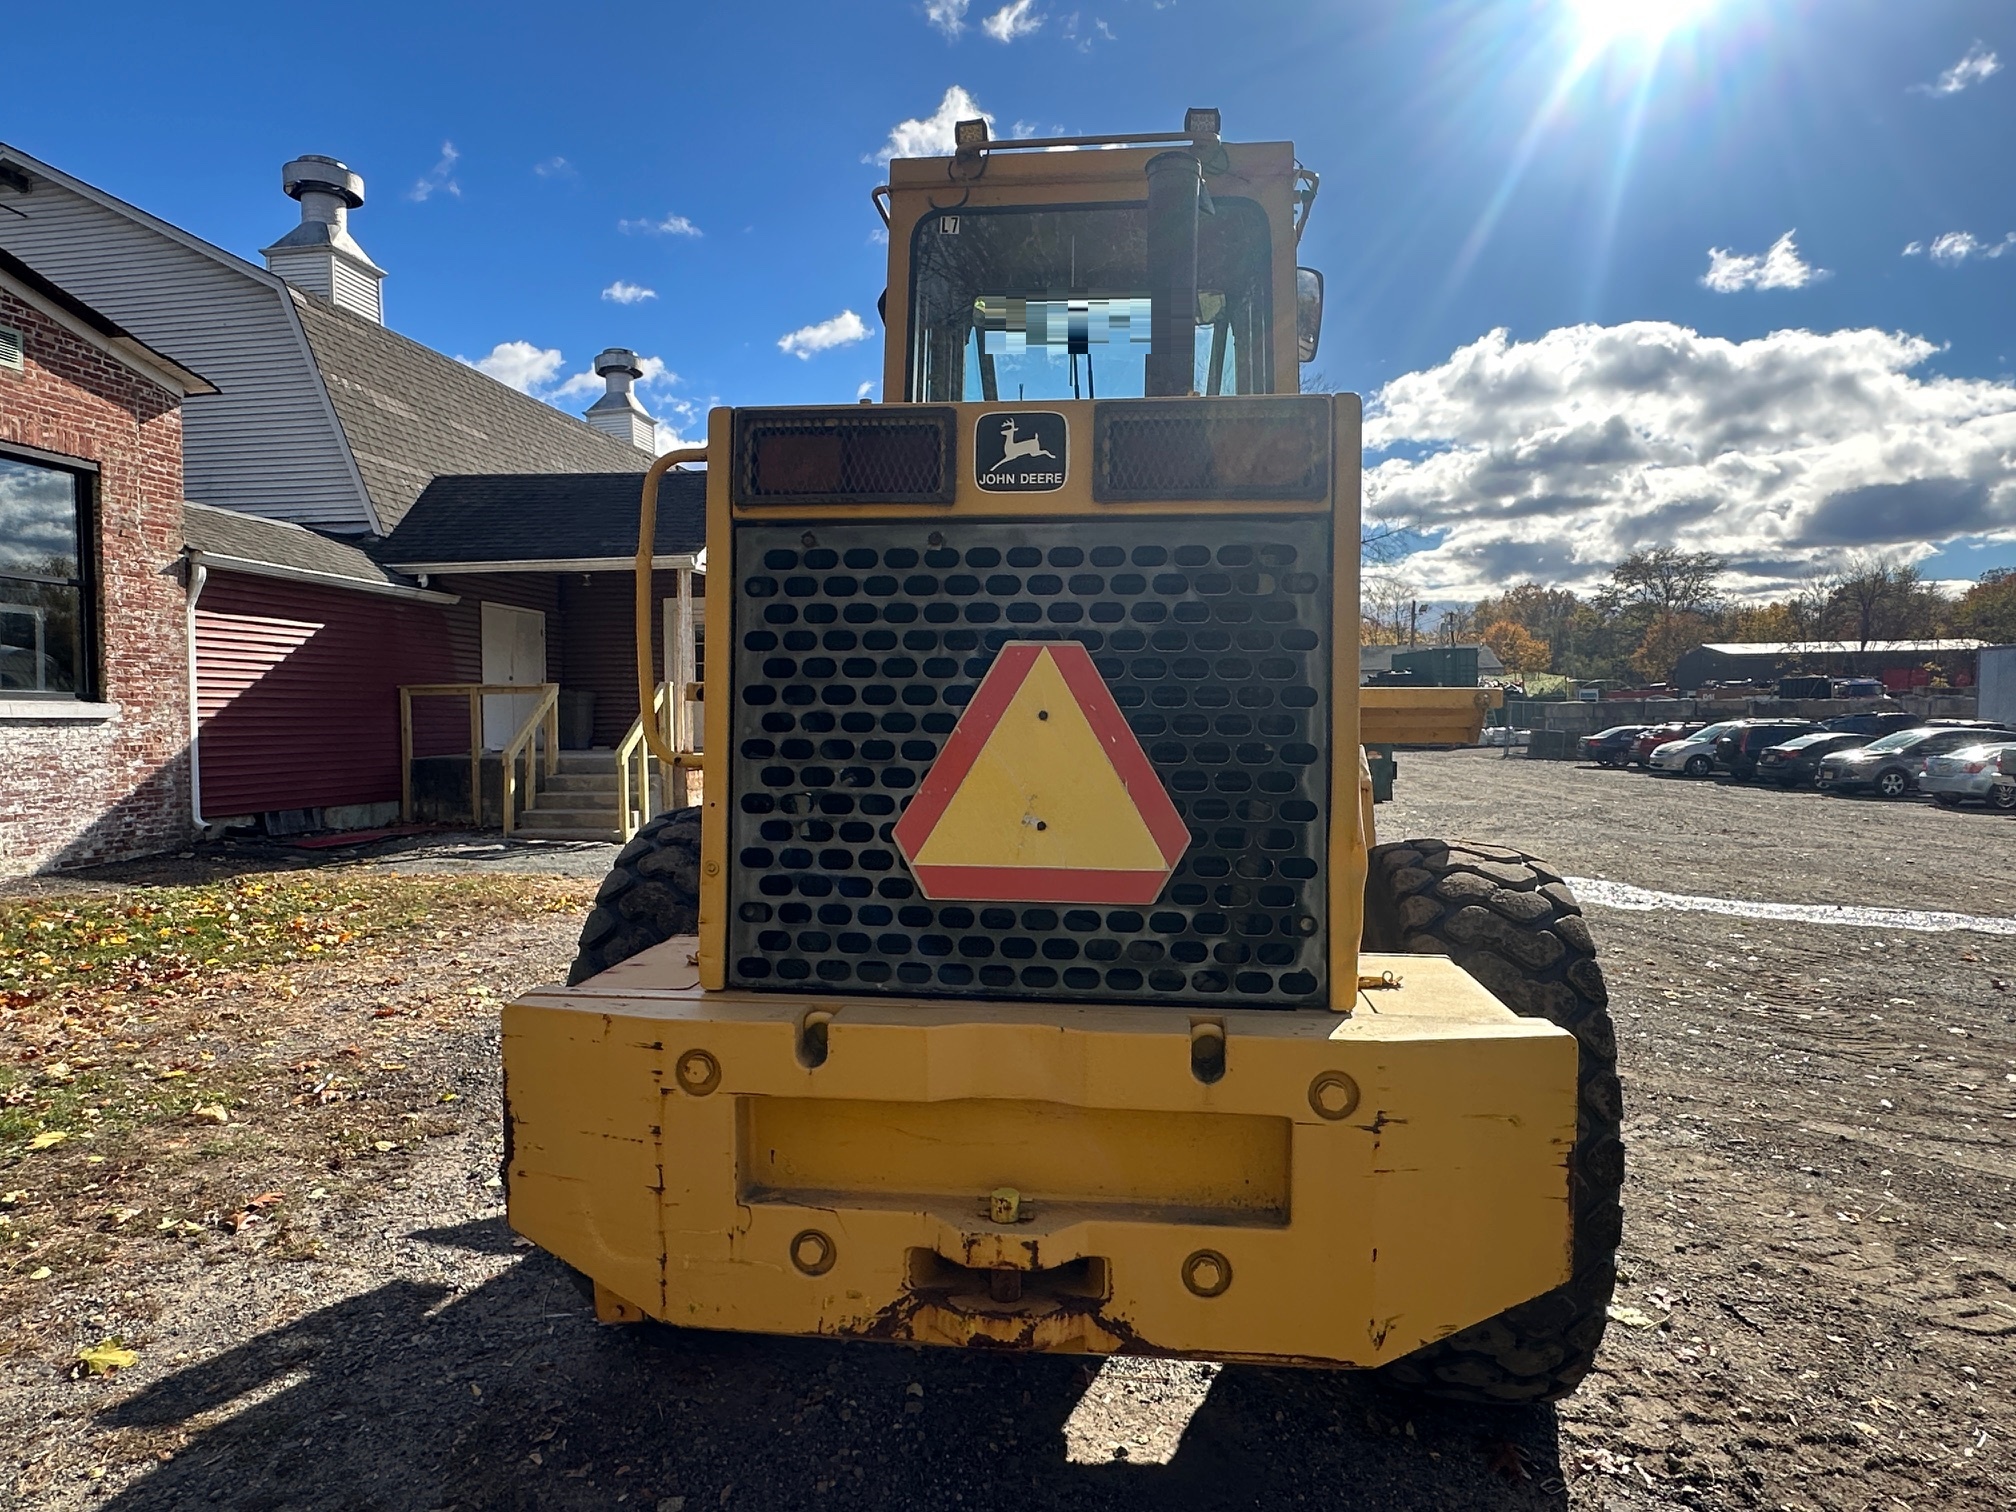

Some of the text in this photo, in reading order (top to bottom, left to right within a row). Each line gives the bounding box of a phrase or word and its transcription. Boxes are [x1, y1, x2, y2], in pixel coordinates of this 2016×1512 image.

[941, 216, 959, 234] L7
[979, 473, 1063, 485] JOHN DEERE
